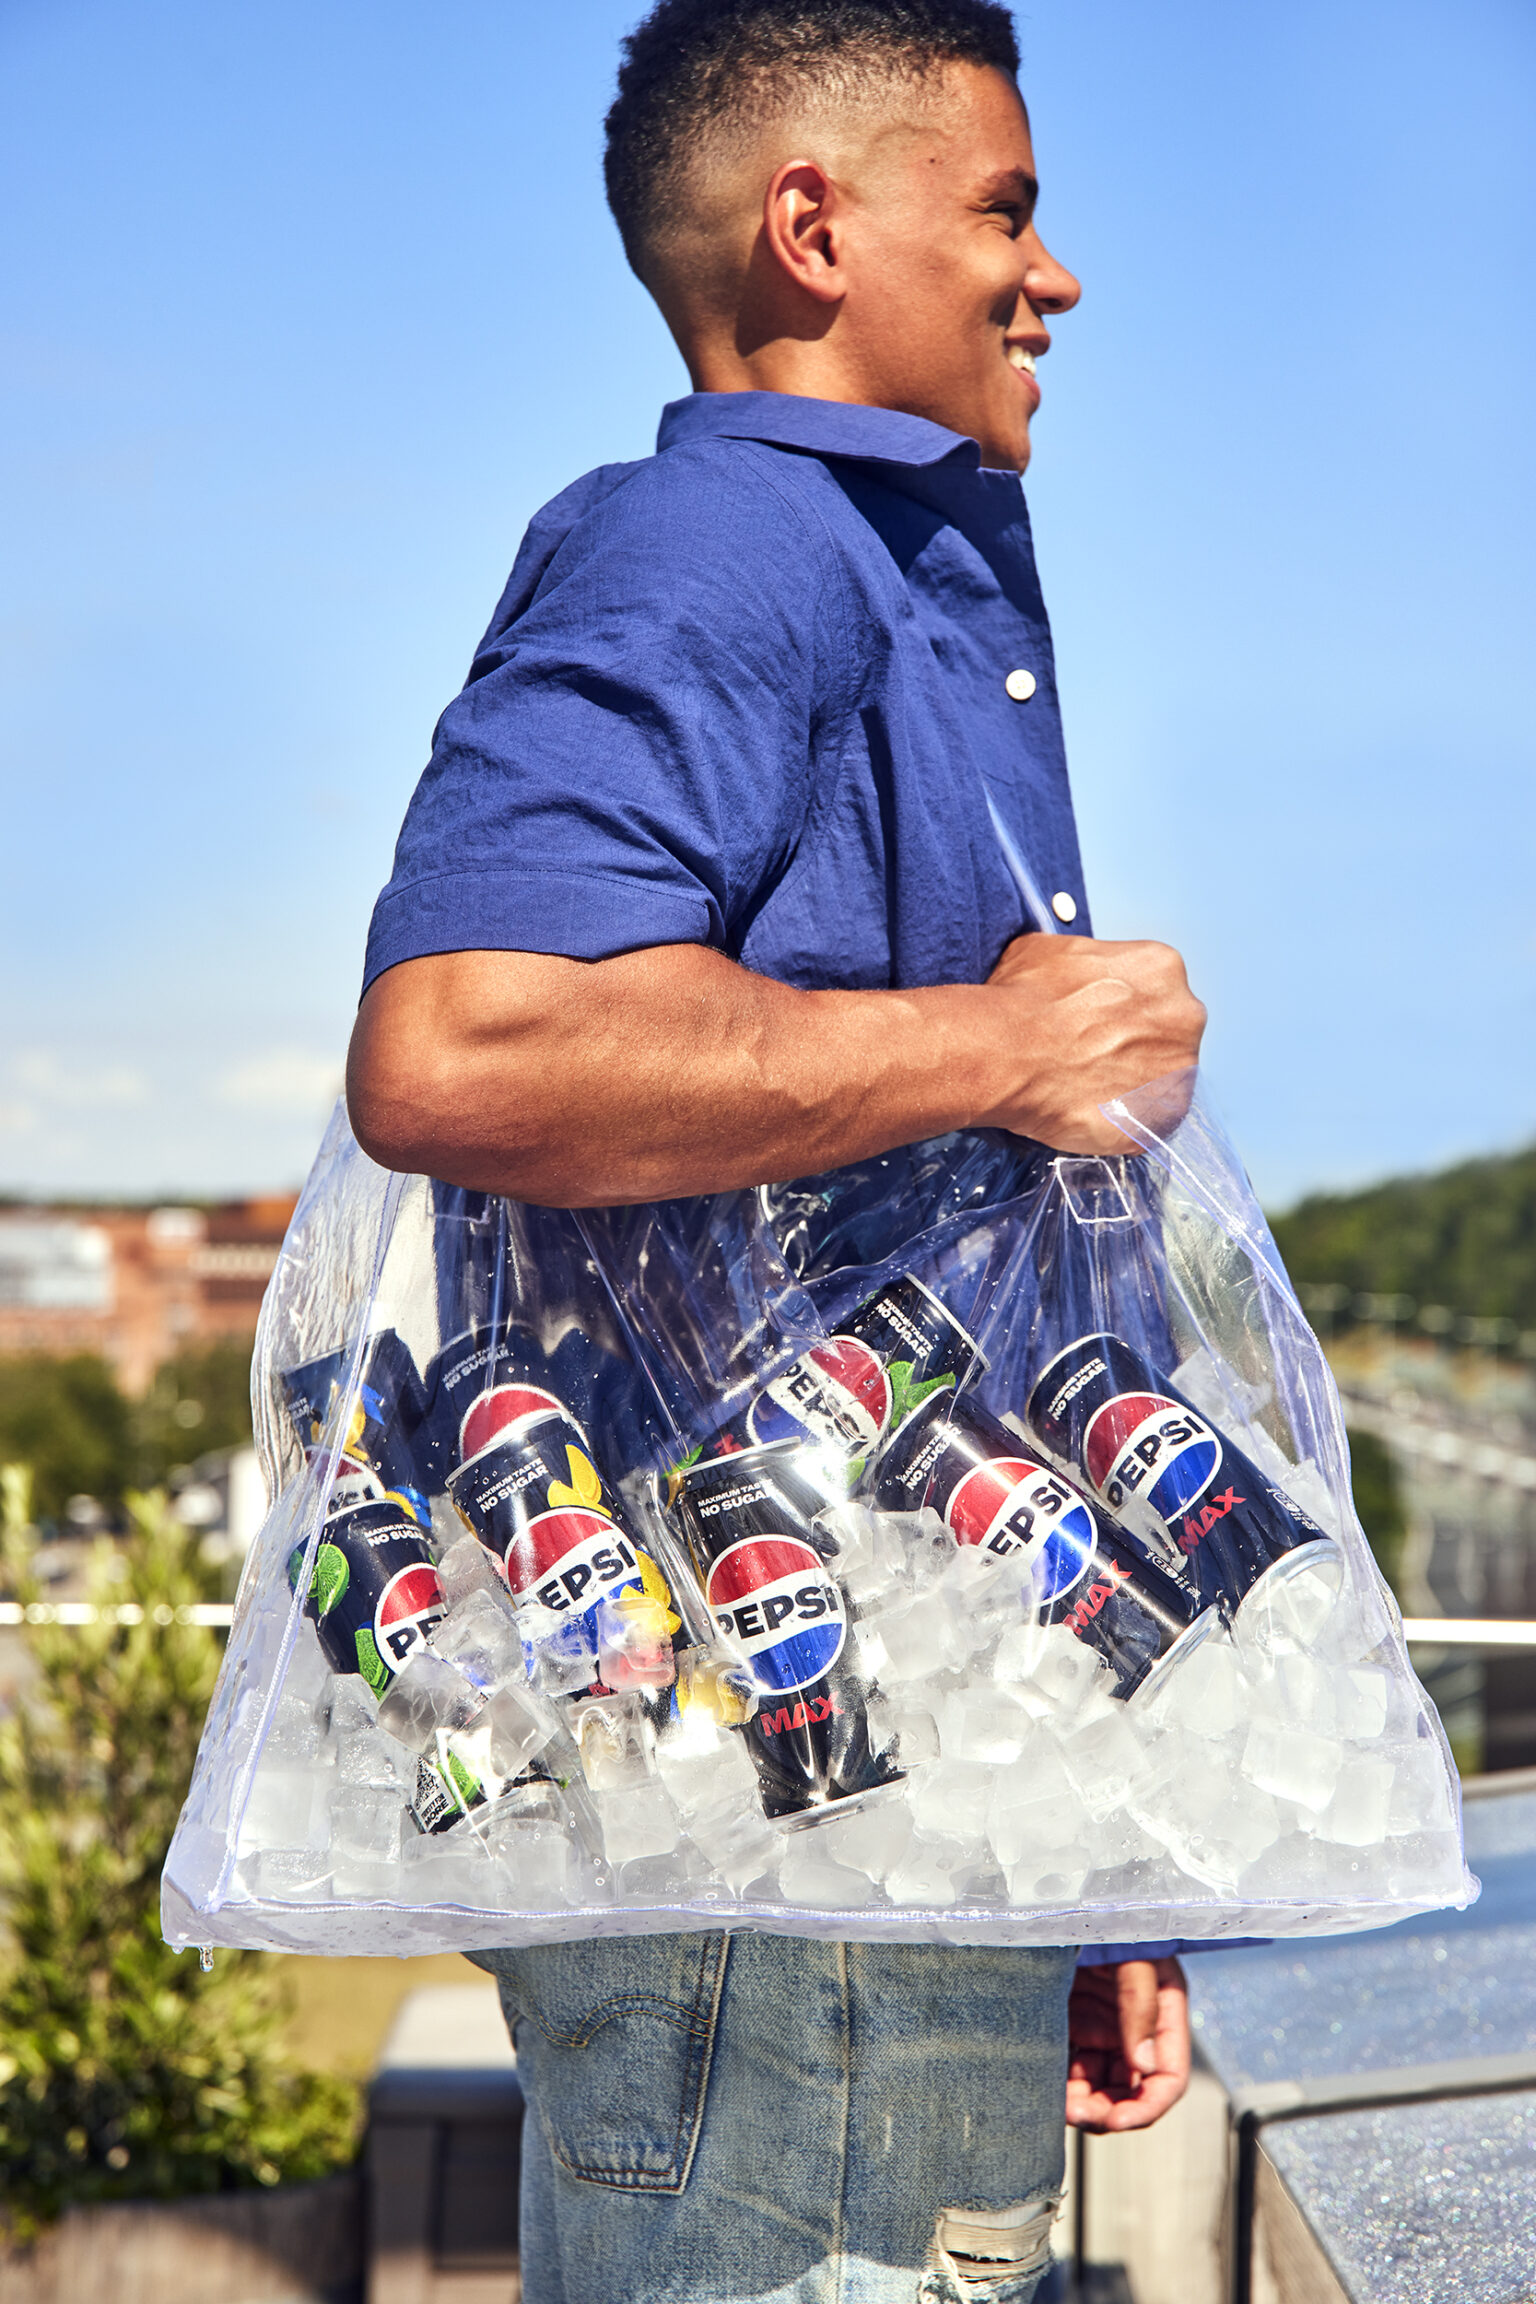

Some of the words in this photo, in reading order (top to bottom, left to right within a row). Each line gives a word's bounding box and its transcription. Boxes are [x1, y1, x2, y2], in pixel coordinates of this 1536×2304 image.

[875, 1303, 891, 1319] NO
[888, 1315, 928, 1359] SUGAR
[1052, 1400, 1067, 1421] NO
[1064, 1362, 1108, 1401] SUGAR
[475, 1474, 514, 1504] MAXIMUM
[511, 1457, 543, 1478] TASTE
[480, 1496, 499, 1514] NO
[498, 1463, 549, 1500] SUGAR
[697, 1487, 740, 1508] MAXIMUM
[906, 1470, 924, 1491] NO
[700, 1504, 720, 1519] NO
[987, 1478, 1073, 1557] EPSI
[1177, 1485, 1248, 1555] MAX
[367, 1534, 390, 1548] NO
[522, 1541, 636, 1611] EPSI
[1063, 1558, 1133, 1636] MAX
[760, 1691, 846, 1737] MAX
[424, 1798, 450, 1828] MORE
